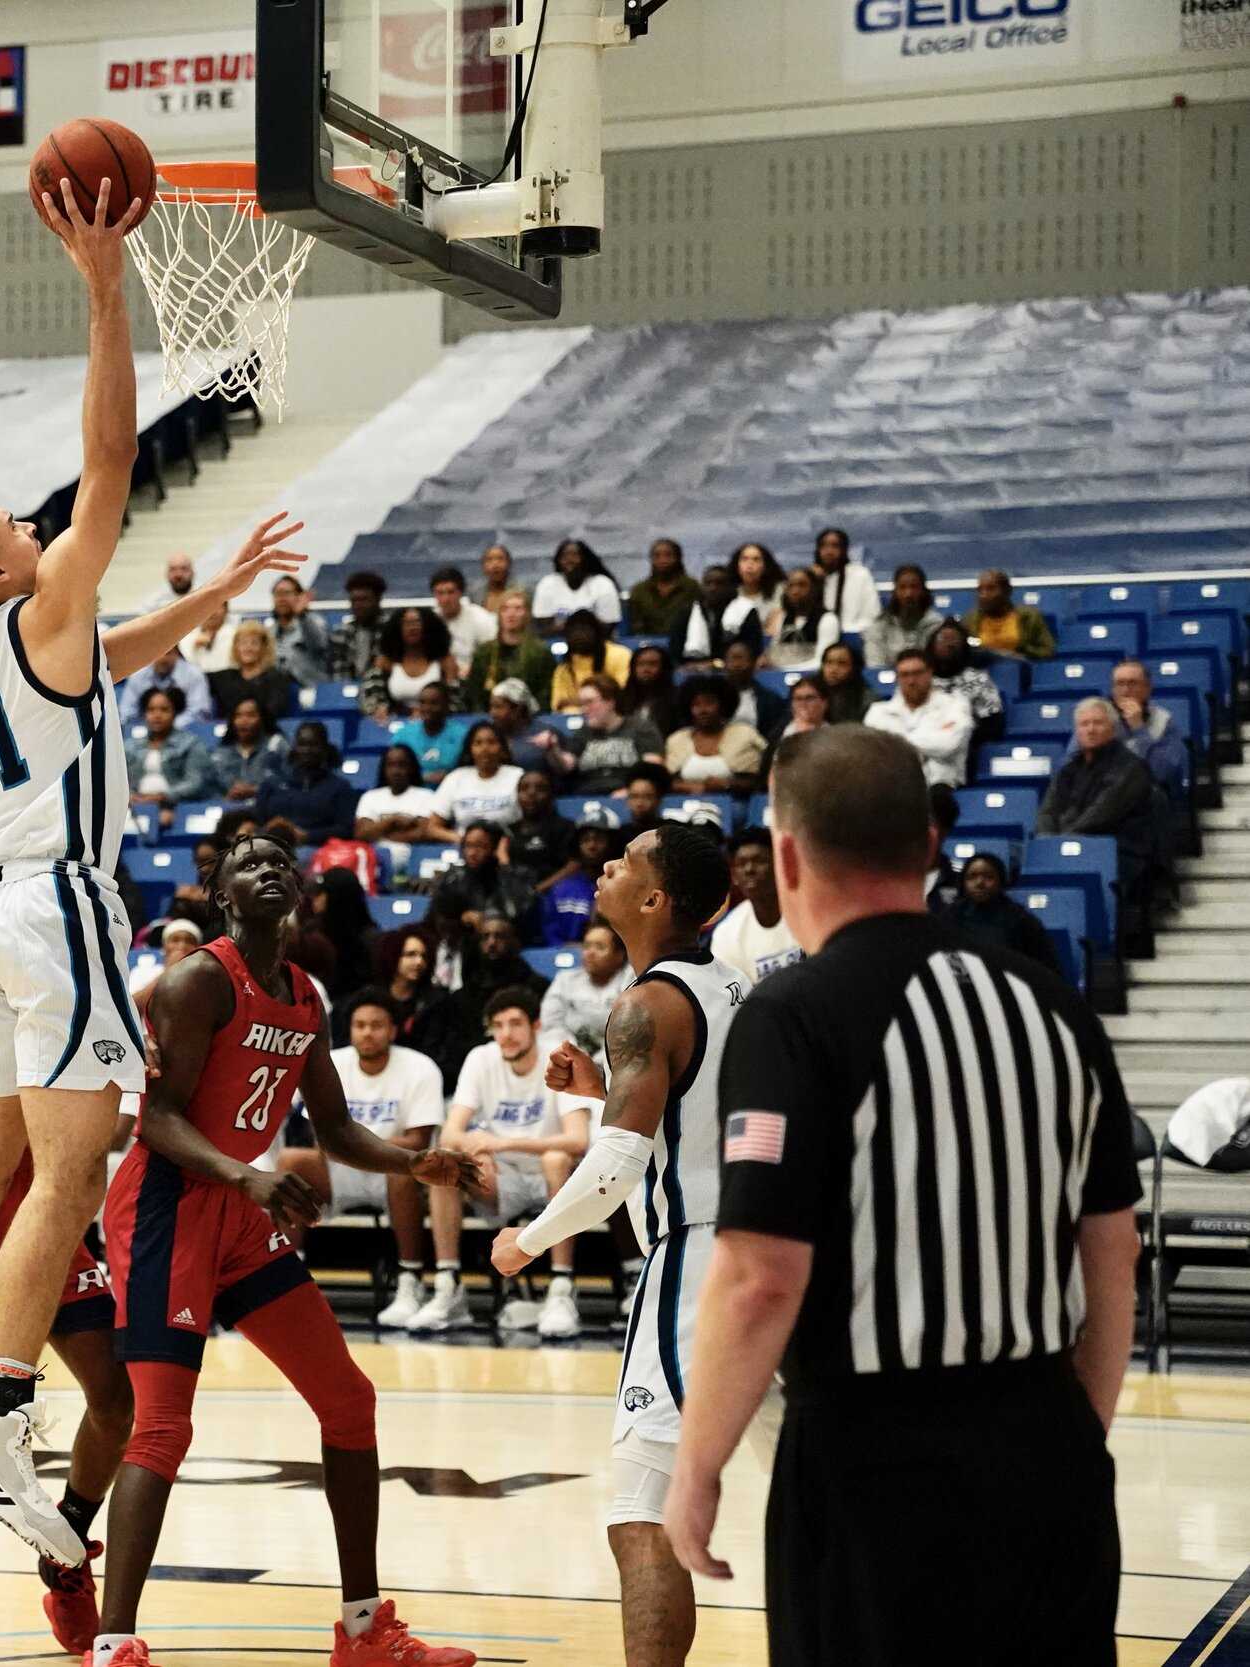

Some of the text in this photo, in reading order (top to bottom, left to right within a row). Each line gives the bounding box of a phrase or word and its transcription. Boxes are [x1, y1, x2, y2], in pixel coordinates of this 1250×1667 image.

[1181, 0, 1250, 14] iHear
[901, 17, 1068, 56] Local Office
[109, 53, 255, 90] DISCOU
[160, 88, 234, 113] TIRE
[241, 1022, 317, 1056] AIKEN
[235, 1065, 288, 1131] 23
